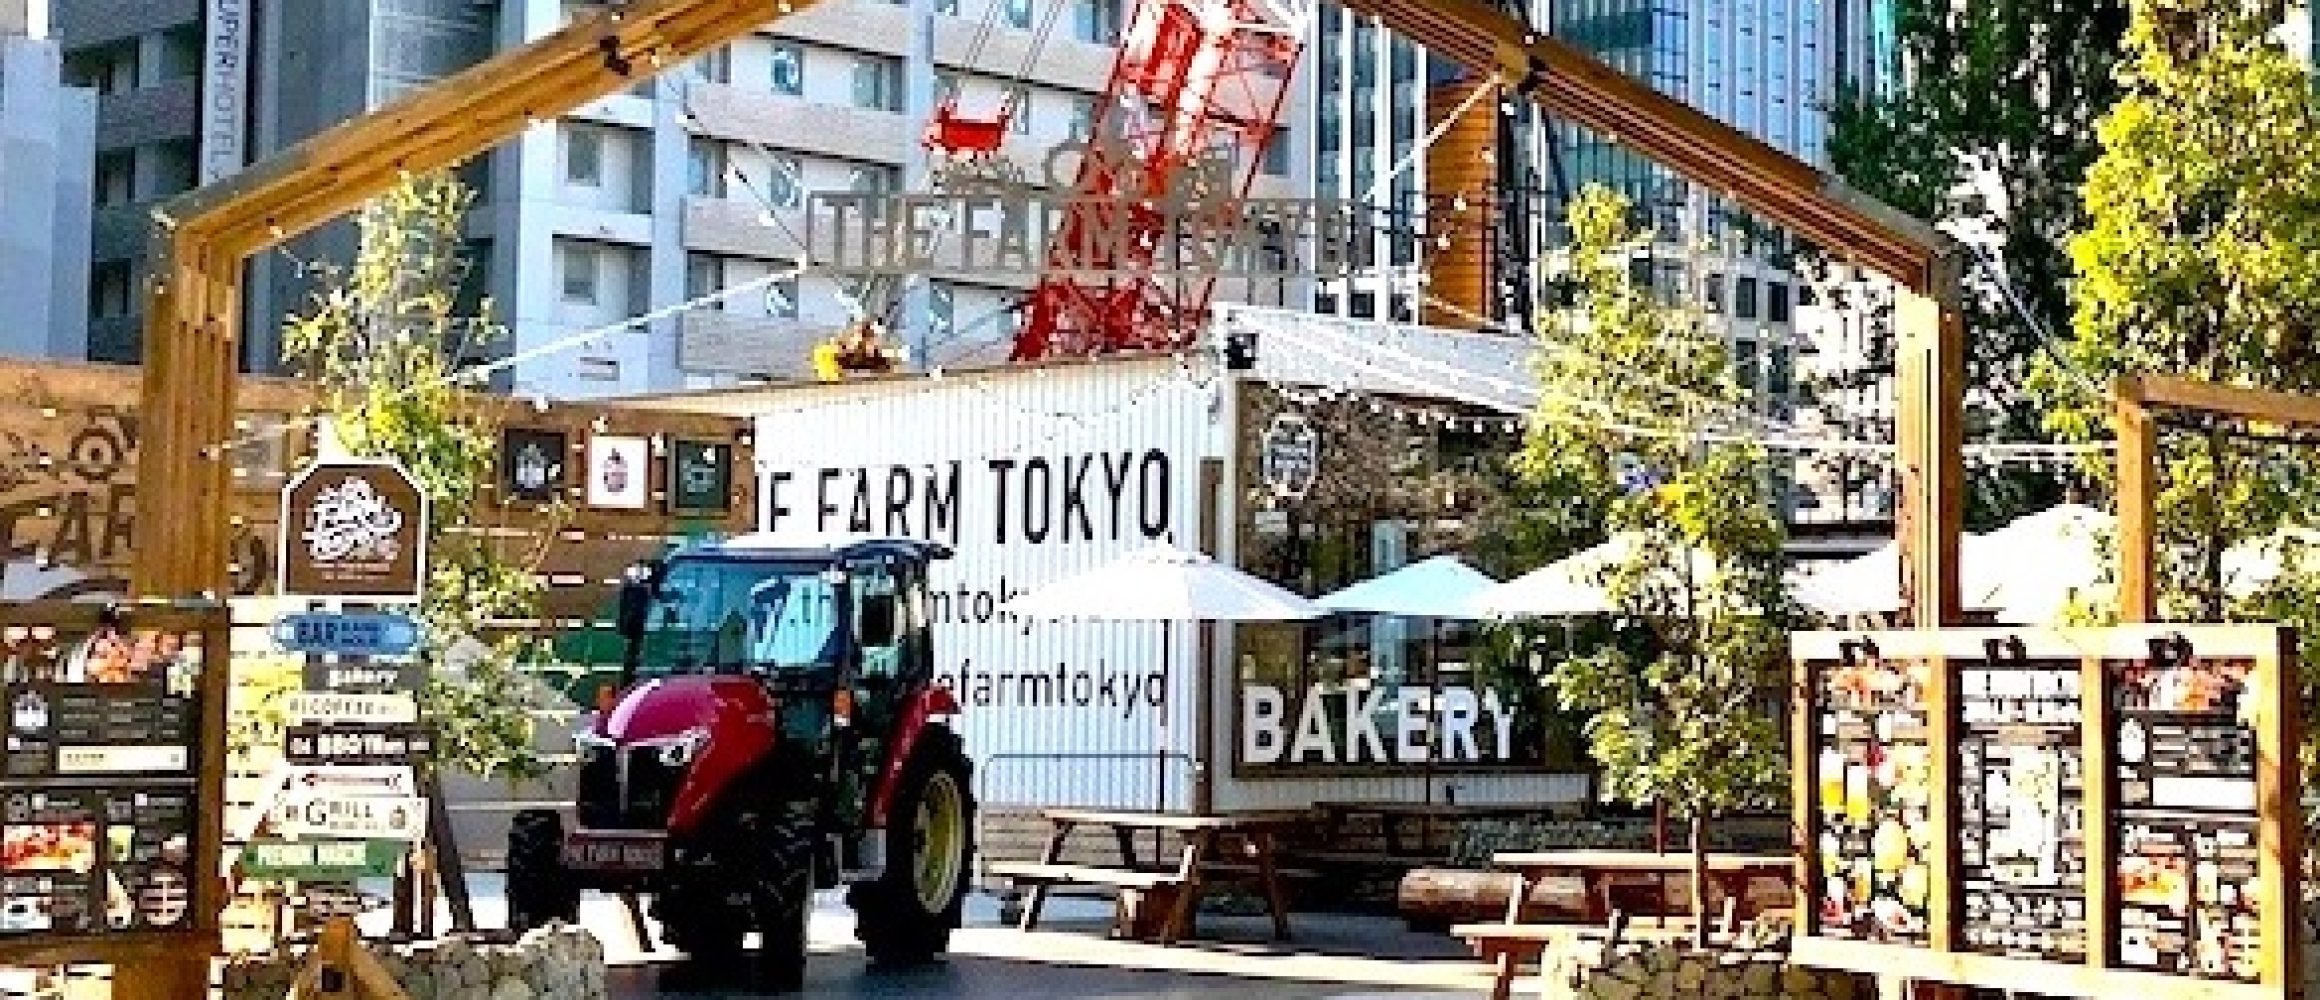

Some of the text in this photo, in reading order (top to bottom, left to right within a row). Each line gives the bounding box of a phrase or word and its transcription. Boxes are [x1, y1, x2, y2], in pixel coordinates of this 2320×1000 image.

[209, 0, 240, 164] UPERHOTEL
[823, 198, 940, 273] THE
[962, 198, 1134, 273] FARM
[817, 459, 961, 544] FARM
[988, 448, 1169, 544] TOKYO
[938, 657, 1166, 720] efarmtokyo
[1242, 684, 1518, 763] BAKERY
